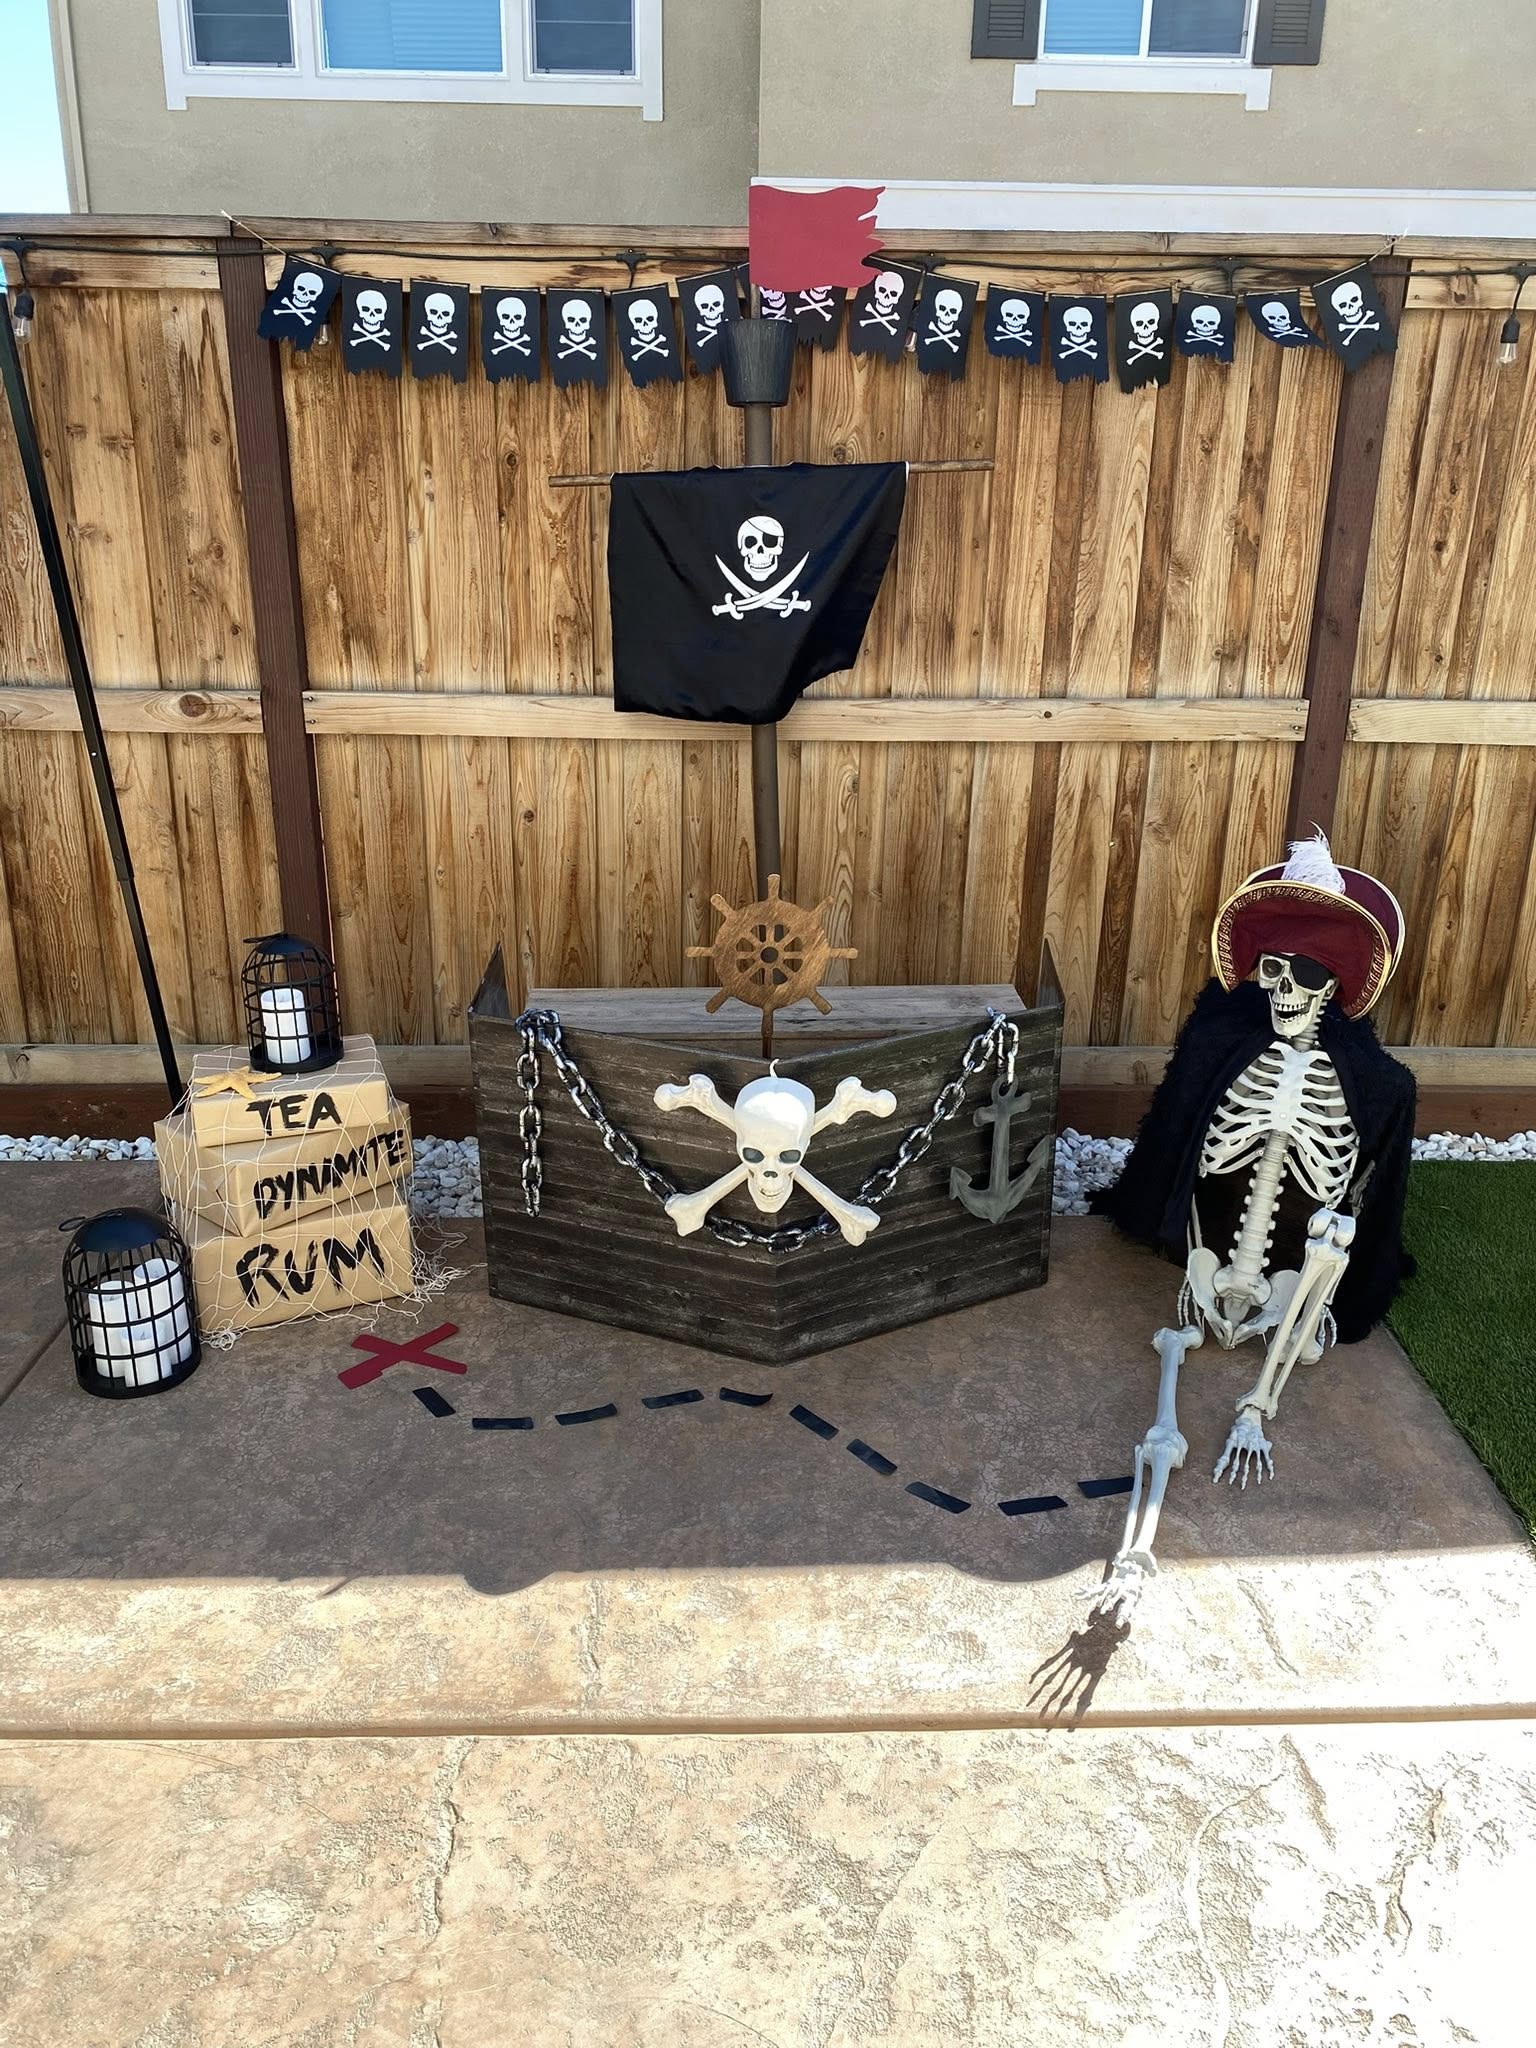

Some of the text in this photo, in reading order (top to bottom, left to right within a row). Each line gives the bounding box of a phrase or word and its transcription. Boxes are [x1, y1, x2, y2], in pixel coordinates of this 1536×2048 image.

[246, 1092, 342, 1136] TEA
[253, 1129, 408, 1219] DYNAMITE
[236, 1228, 385, 1308] RUM
